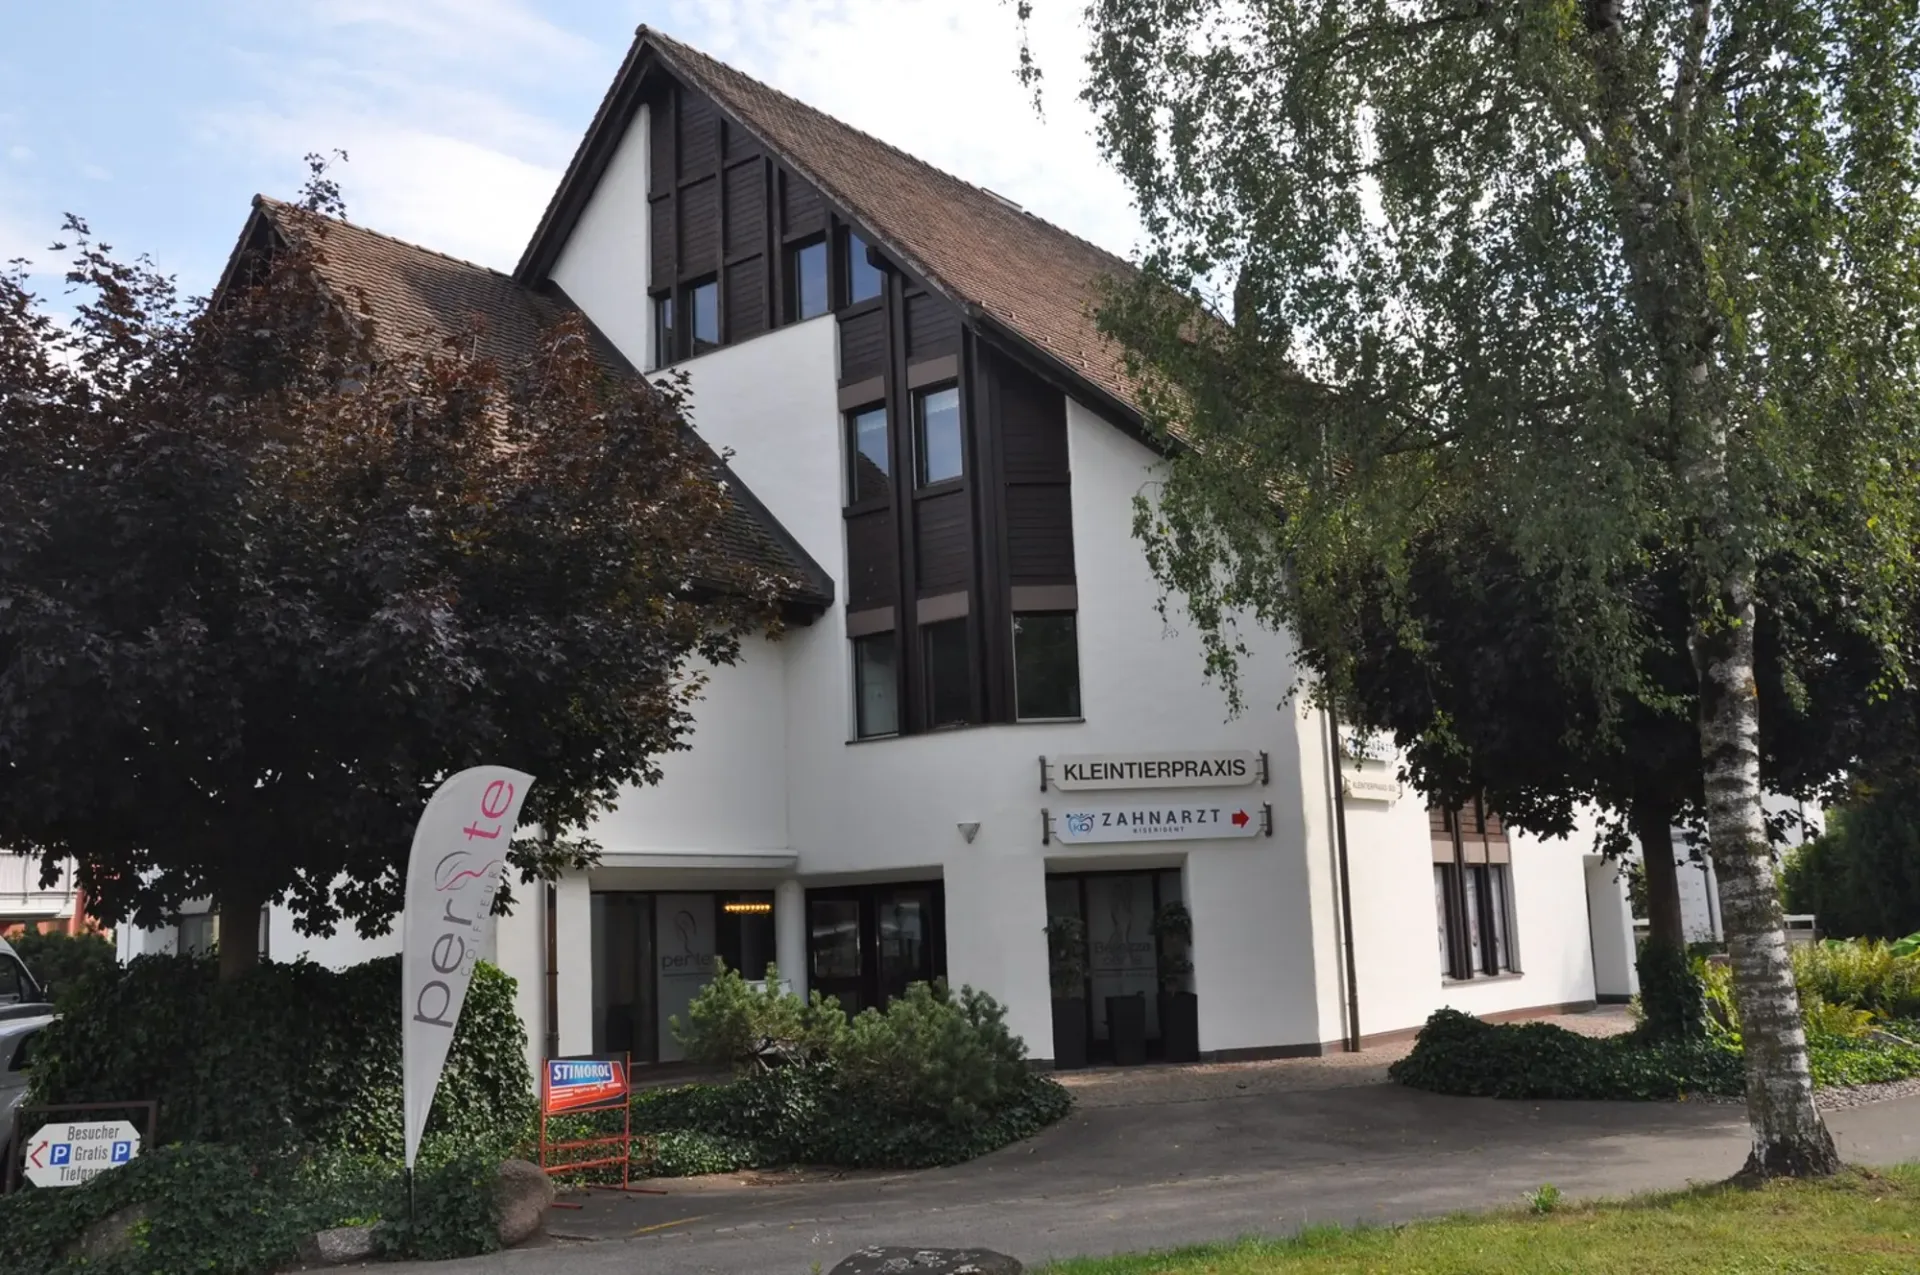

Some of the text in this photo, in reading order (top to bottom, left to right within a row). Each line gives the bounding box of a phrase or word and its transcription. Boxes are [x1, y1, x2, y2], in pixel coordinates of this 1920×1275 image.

[1063, 758, 1246, 781] KLEINTIERPRAXIS
[1102, 808, 1221, 827] ZAHNARZT
[412, 779, 515, 1029] per te
[460, 869, 498, 977] COIFFEUR
[553, 1063, 610, 1081] STIMOROL
[67, 1124, 120, 1142] Besucher
[53, 1143, 127, 1163] P Gratis P
